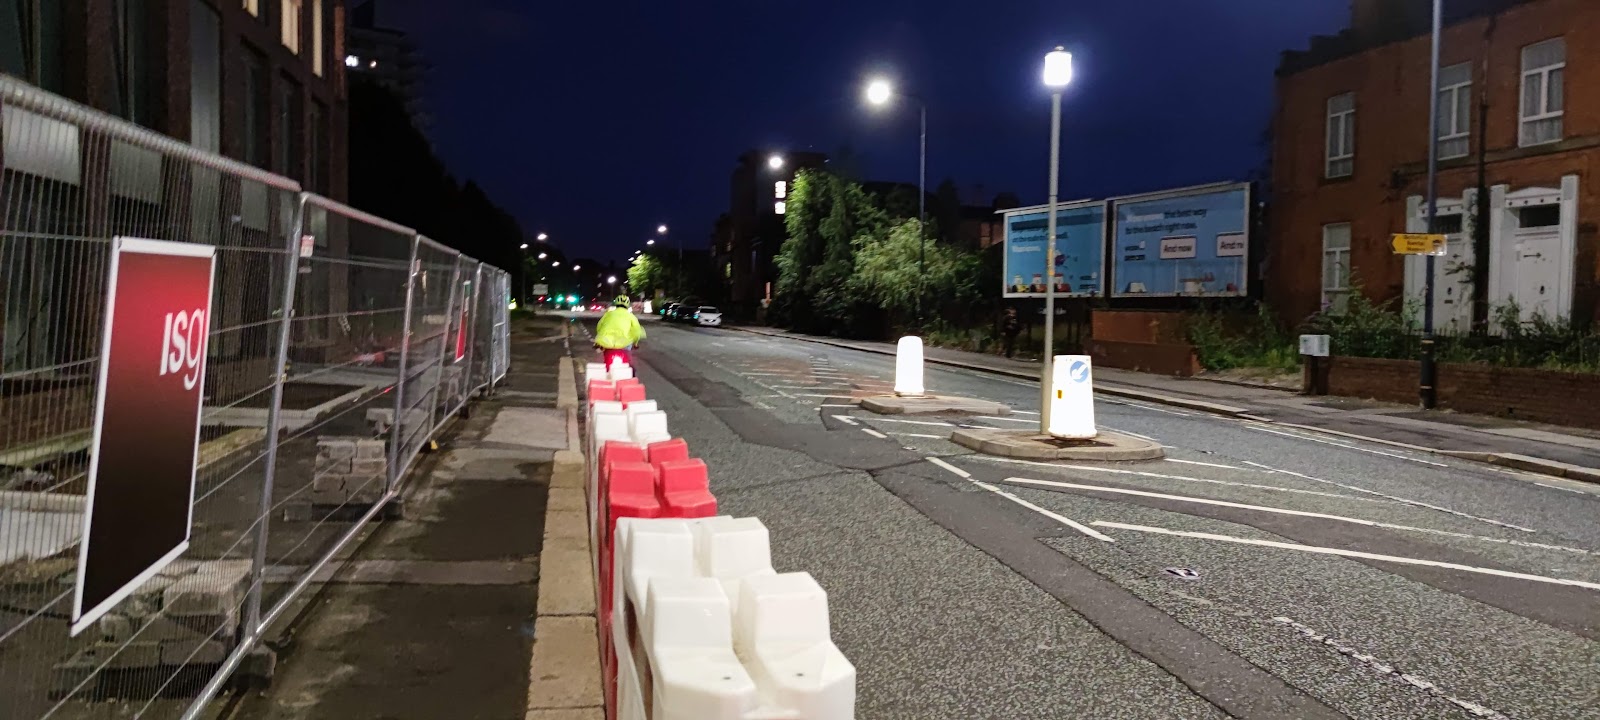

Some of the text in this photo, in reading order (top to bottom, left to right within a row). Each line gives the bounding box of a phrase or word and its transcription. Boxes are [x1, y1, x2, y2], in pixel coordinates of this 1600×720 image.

[1163, 244, 1177, 253] And
[1220, 241, 1236, 249] And
[159, 308, 205, 391] isg
